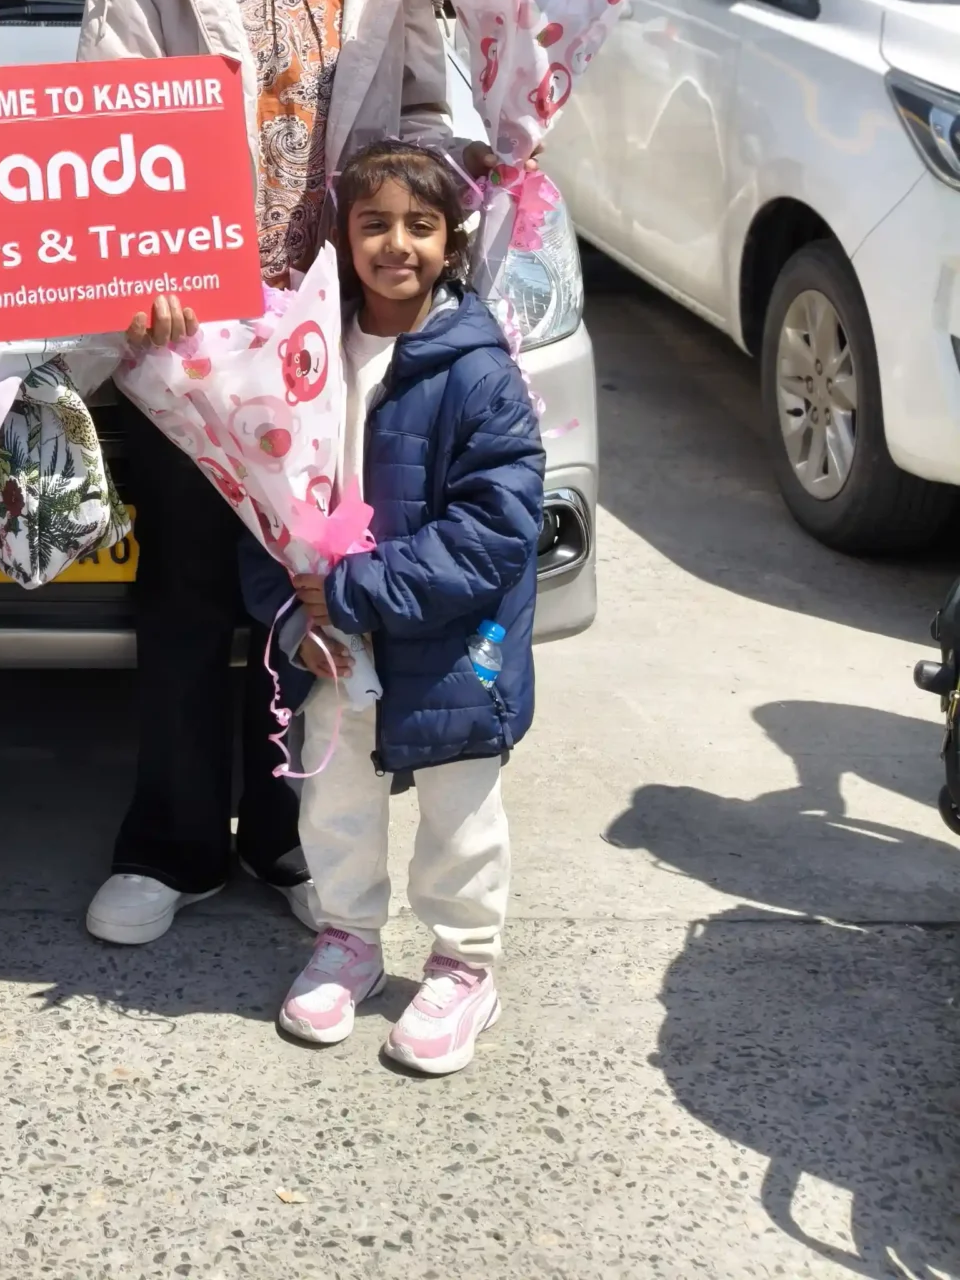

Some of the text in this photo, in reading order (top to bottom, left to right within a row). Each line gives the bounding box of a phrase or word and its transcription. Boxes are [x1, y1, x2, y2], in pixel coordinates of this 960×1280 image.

[44, 86, 84, 113] TO
[93, 78, 223, 111] KASHMIR
[37, 229, 77, 264] &
[88, 216, 245, 259] Travels
[431, 955, 460, 969] PUMA
